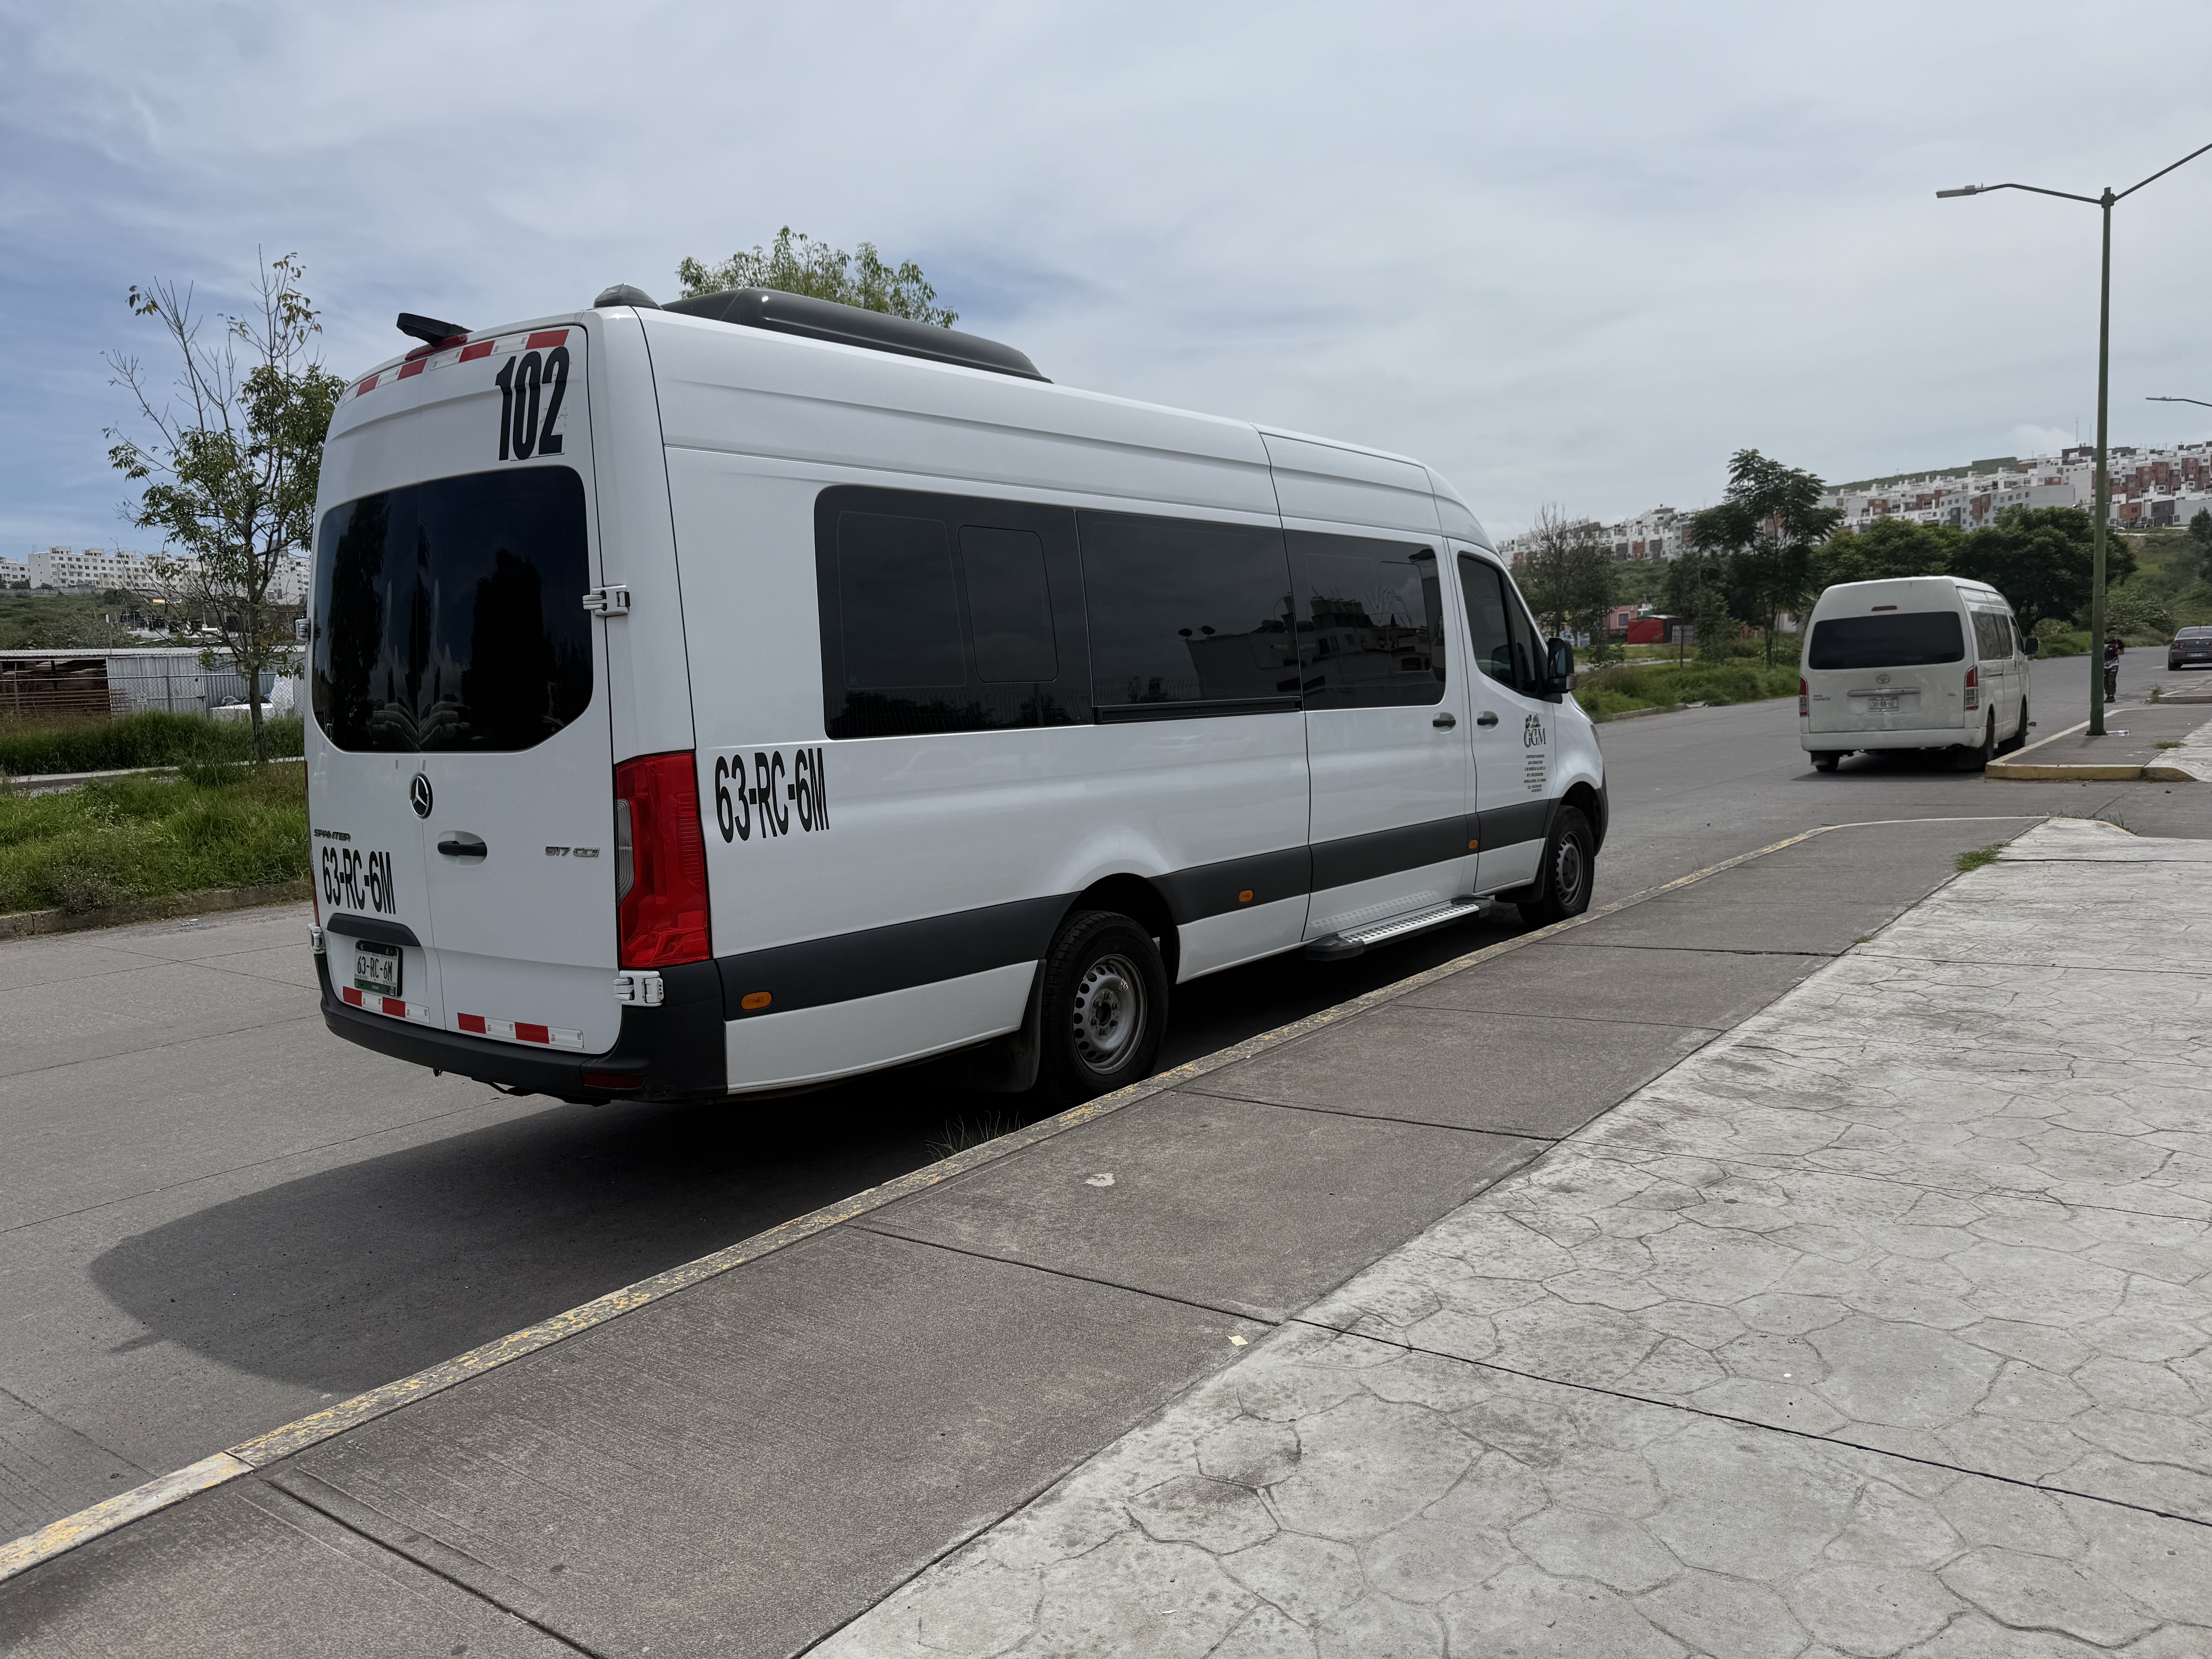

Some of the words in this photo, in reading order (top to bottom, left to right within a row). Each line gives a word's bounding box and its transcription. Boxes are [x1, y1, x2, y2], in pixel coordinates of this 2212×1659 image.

[495, 347, 569, 460] 102
[715, 748, 829, 843] 63-RC-6M
[314, 829, 351, 842] SPRINTER
[545, 847, 571, 856] 517
[323, 846, 396, 914] 63-RC-6M
